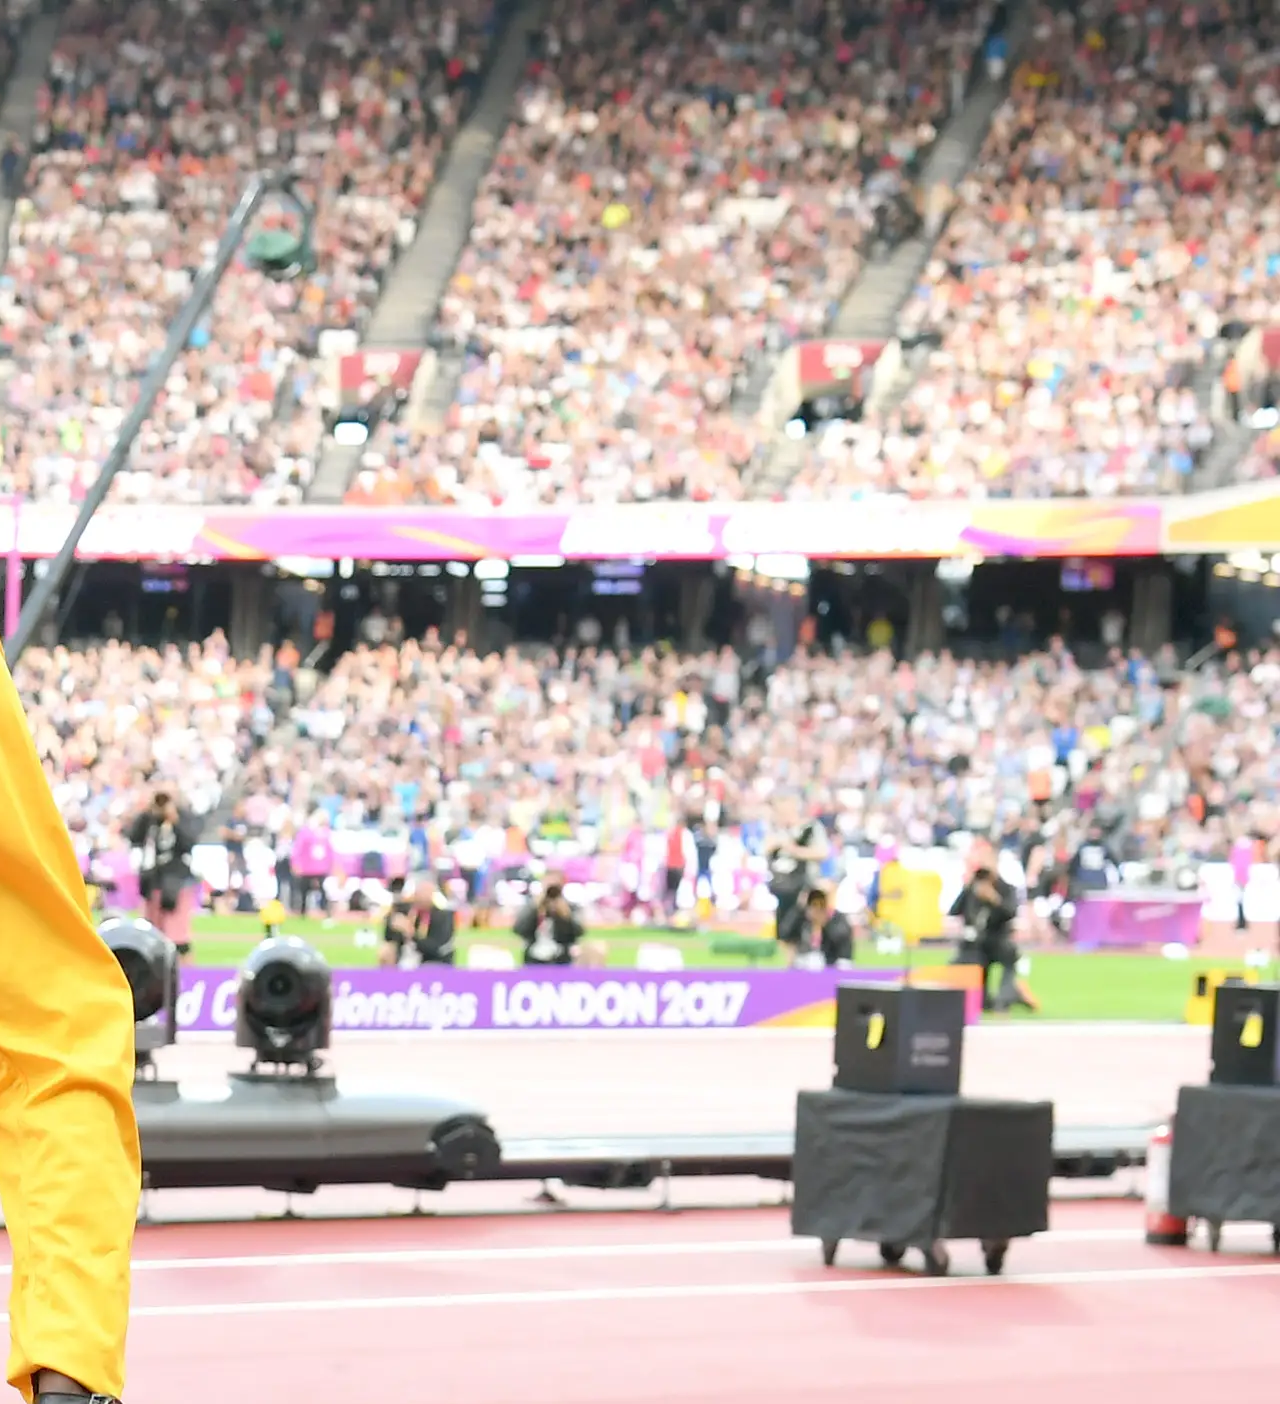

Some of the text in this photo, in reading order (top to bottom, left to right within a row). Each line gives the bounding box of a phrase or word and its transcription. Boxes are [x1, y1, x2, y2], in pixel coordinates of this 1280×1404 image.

[211, 979, 478, 1028] Cionships
[493, 980, 658, 1027] LONDON
[660, 980, 751, 1027] 2017
